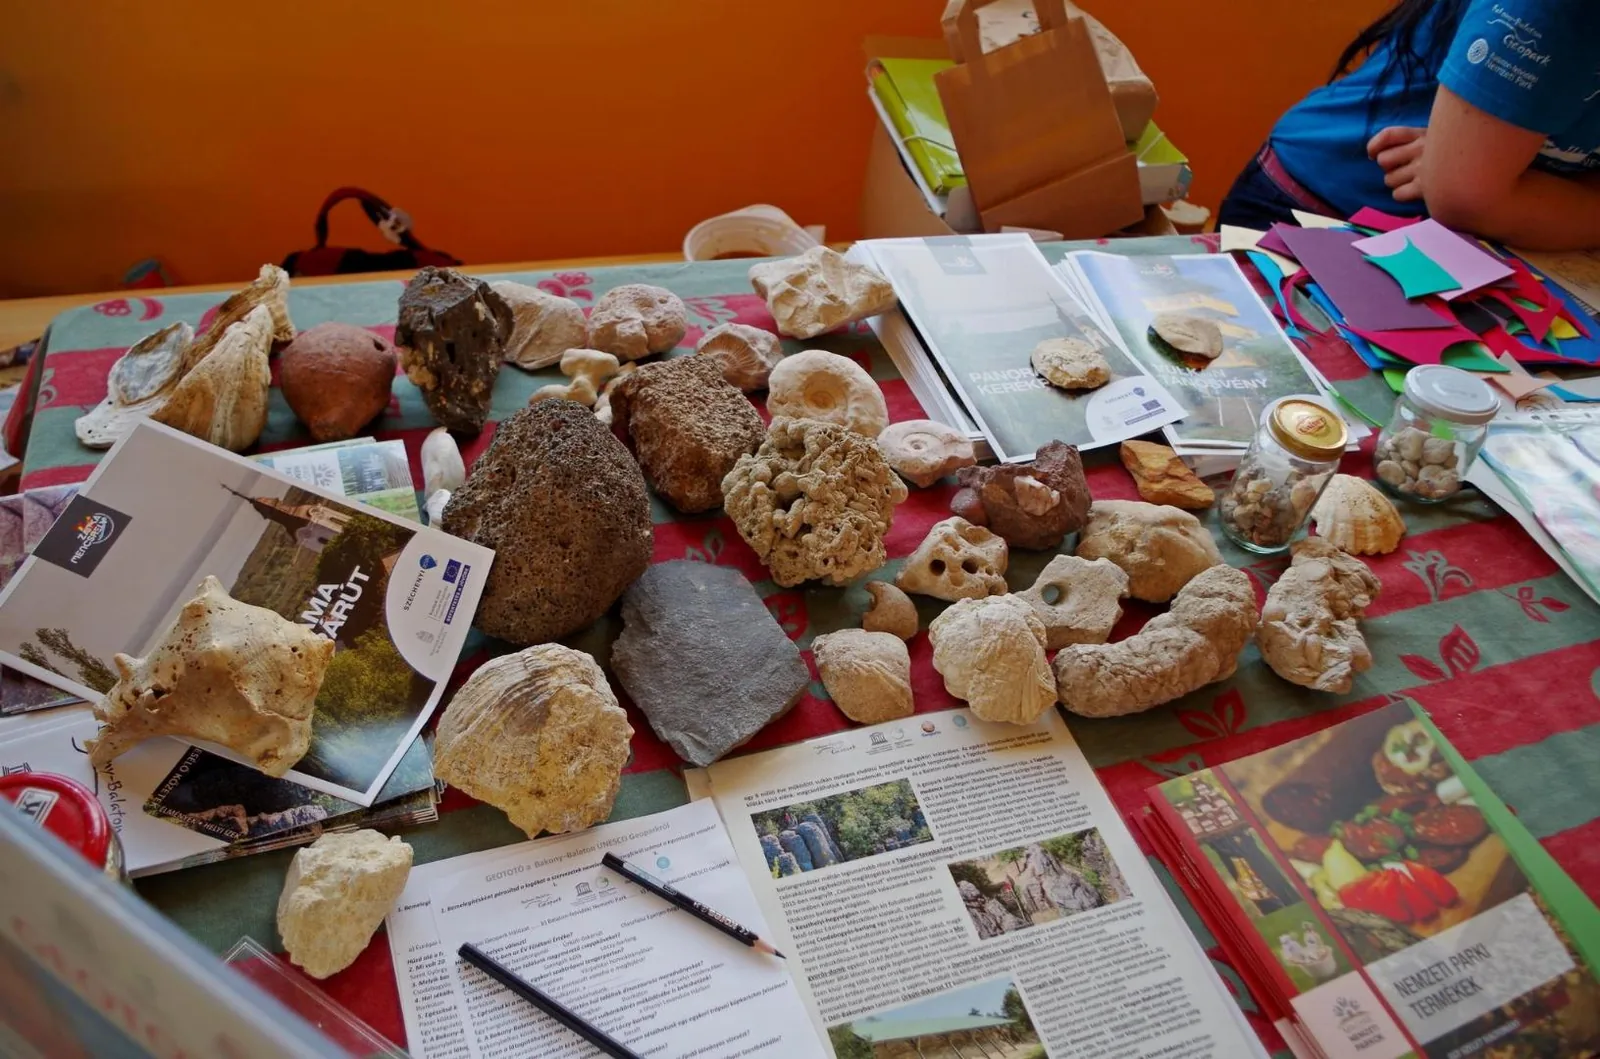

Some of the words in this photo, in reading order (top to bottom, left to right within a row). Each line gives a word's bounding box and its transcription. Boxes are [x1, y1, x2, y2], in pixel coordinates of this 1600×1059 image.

[1503, 34, 1551, 67] Geopark
[969, 367, 1035, 383] PANOR
[977, 377, 1046, 396] KERÉKP
[178, 747, 202, 773] ESÉLŐ
[103, 760, 126, 833] ny-Balaton
[1392, 958, 1453, 999] NEMZETI
[1447, 941, 1491, 972] PARKI
[1408, 975, 1483, 1020] TERMÉKEK
